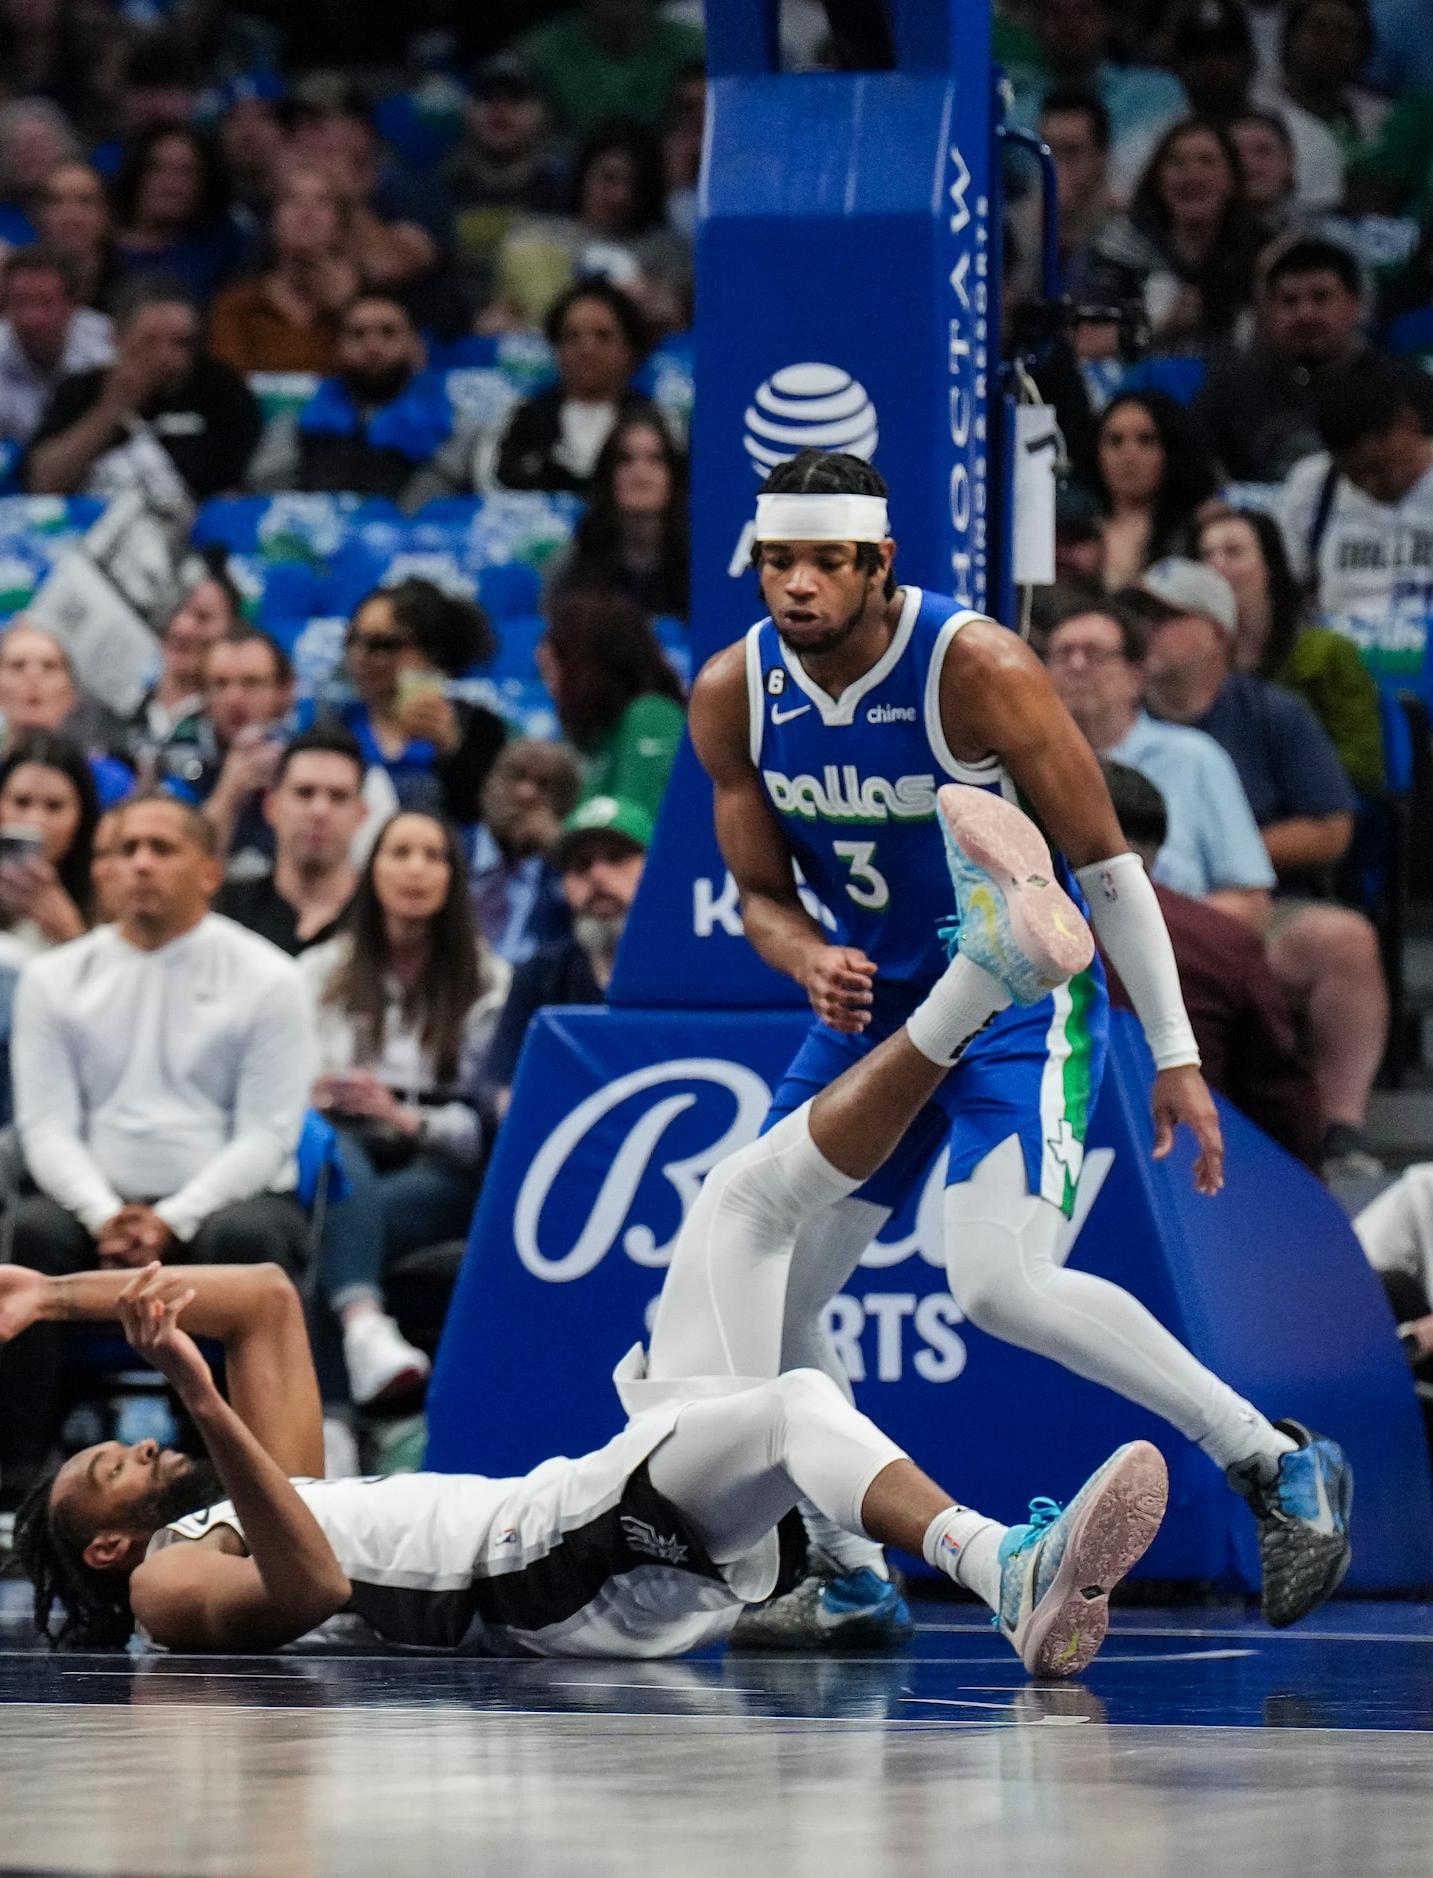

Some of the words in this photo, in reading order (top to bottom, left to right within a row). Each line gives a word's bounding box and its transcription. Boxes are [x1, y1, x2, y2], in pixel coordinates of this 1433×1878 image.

[974, 195, 988, 399] RESORTS
[949, 147, 973, 609] HOCTAW
[767, 668, 785, 695] 6
[866, 703, 917, 724] chime
[832, 839, 890, 911] 3
